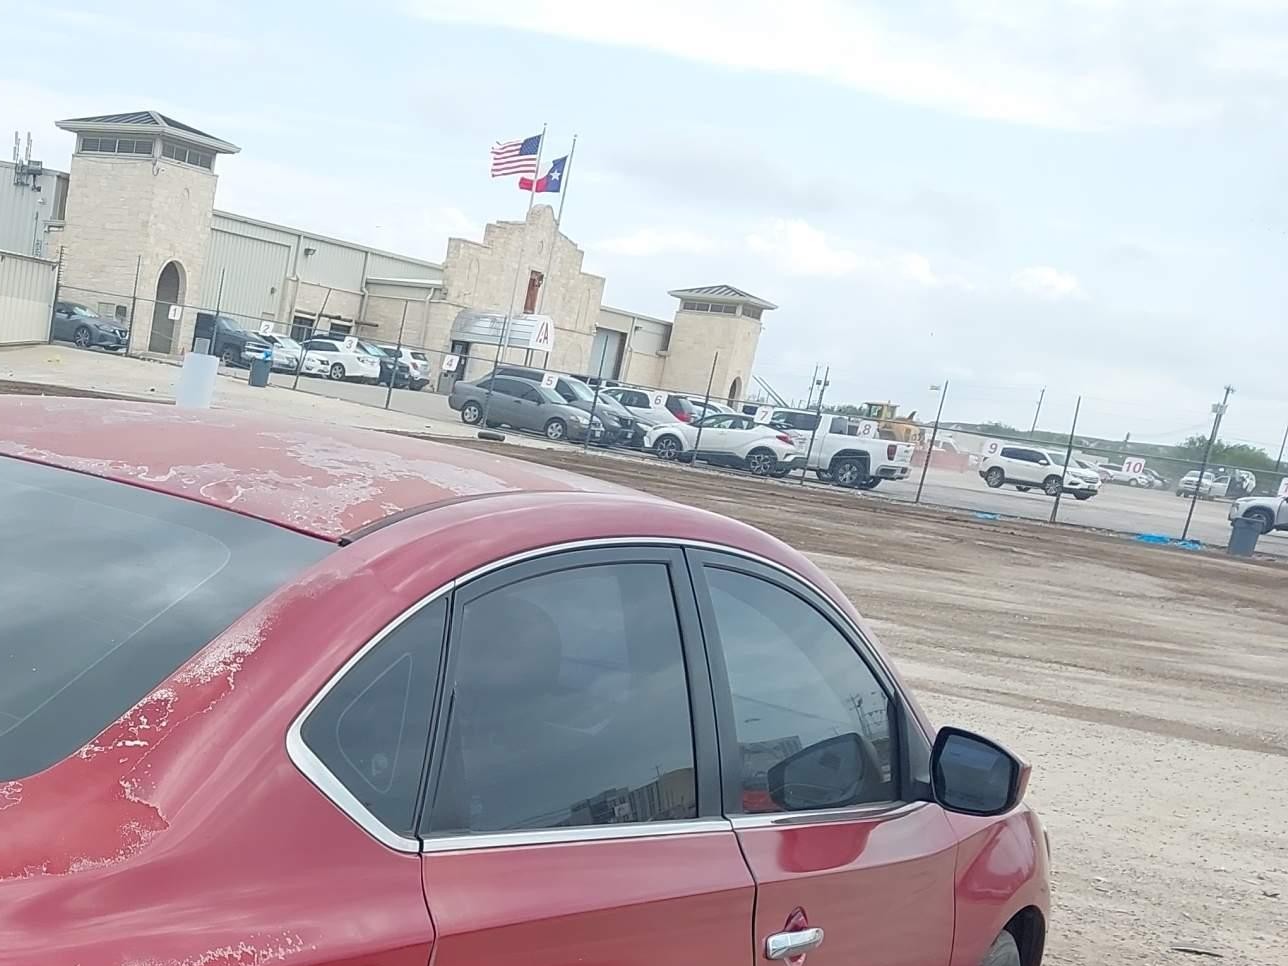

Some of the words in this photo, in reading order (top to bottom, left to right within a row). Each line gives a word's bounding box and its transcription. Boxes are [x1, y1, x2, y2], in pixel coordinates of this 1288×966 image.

[345, 341, 353, 350] 3
[546, 376, 553, 386] 5
[654, 395, 662, 405] 6
[760, 410, 769, 421] 7
[862, 424, 871, 435] 8
[989, 442, 998, 454] 9
[1125, 461, 1143, 474] 10
